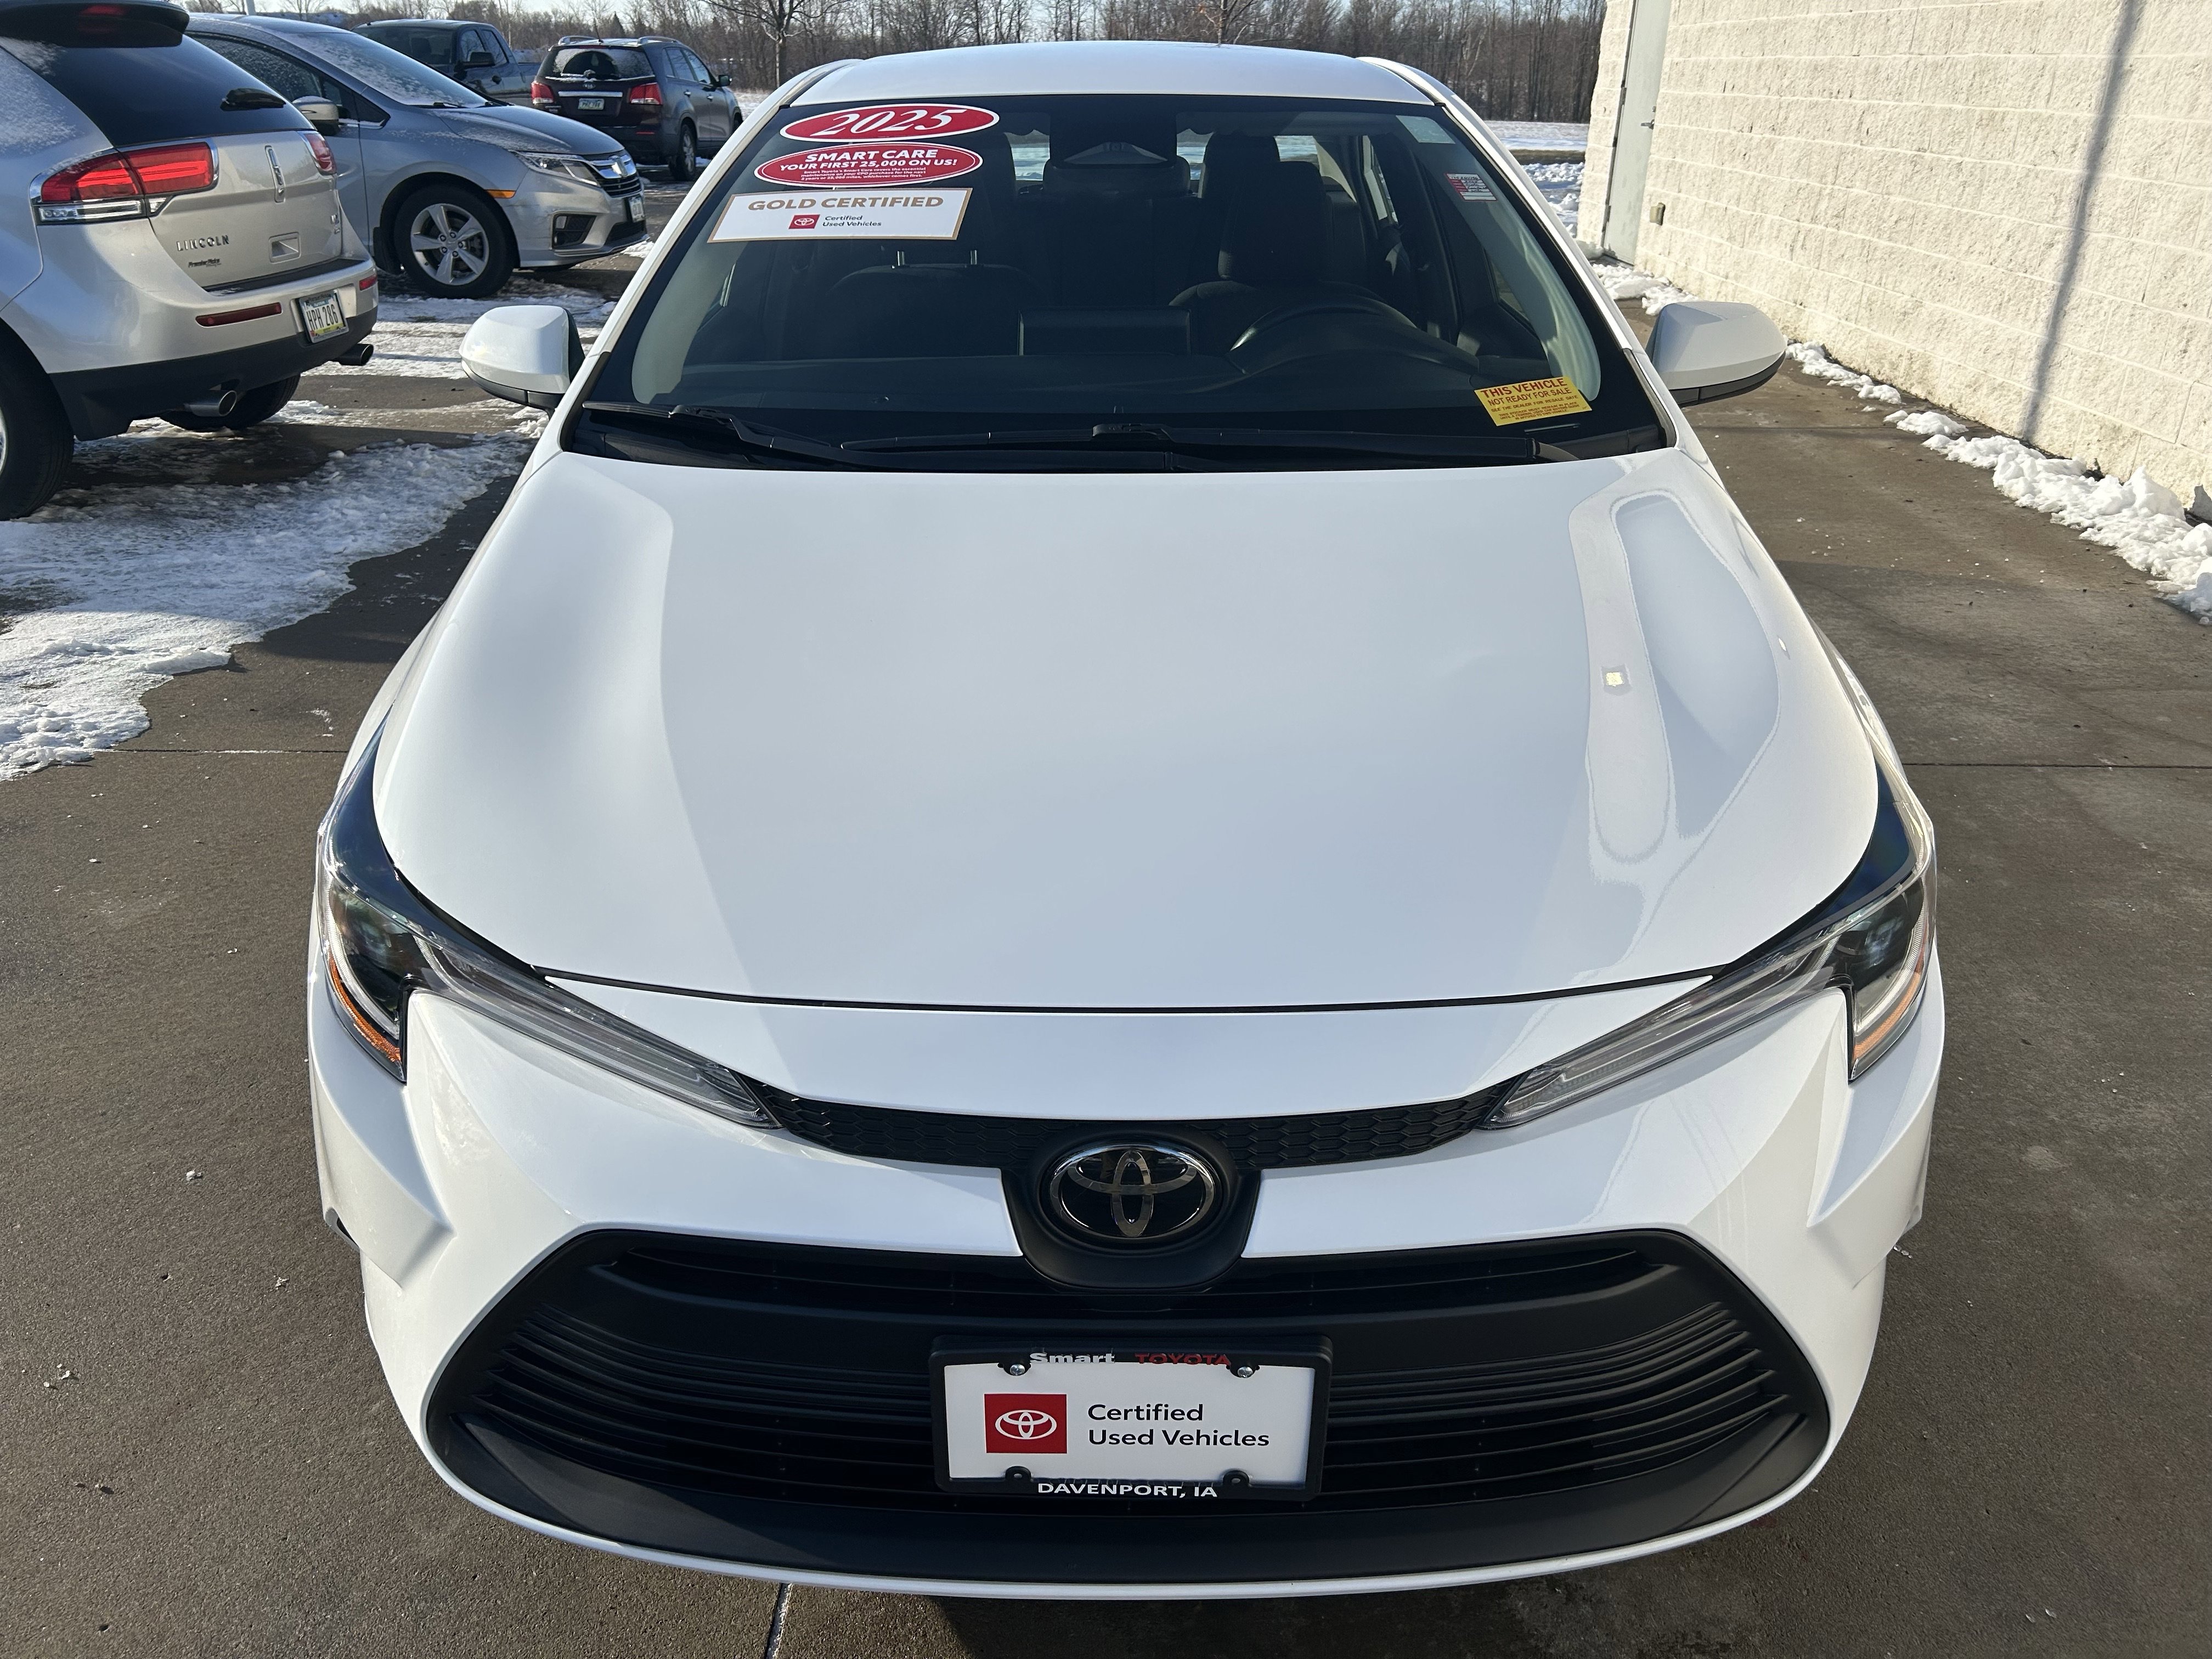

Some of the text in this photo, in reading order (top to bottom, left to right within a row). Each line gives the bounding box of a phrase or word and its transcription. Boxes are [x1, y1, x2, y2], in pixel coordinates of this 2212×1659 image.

[810, 109, 967, 137] 2025
[805, 149, 938, 162] SMART CARE
[780, 163, 817, 171] YOUR
[859, 160, 906, 168] 25,000
[748, 196, 944, 211] GOLD CERTIFIED
[176, 235, 229, 251] LINCOLN
[306, 304, 338, 330] HPH 286
[1480, 378, 1568, 398] THIS VEHICLE
[1487, 387, 1572, 407] NOT READY FOR SALE
[1030, 1352, 1231, 1365] Smart TOYOTA
[1088, 1403, 1203, 1421] Certified
[1089, 1429, 1269, 1447] Used Vehicles
[1039, 1483, 1217, 1498] DAVENPORT, IA
